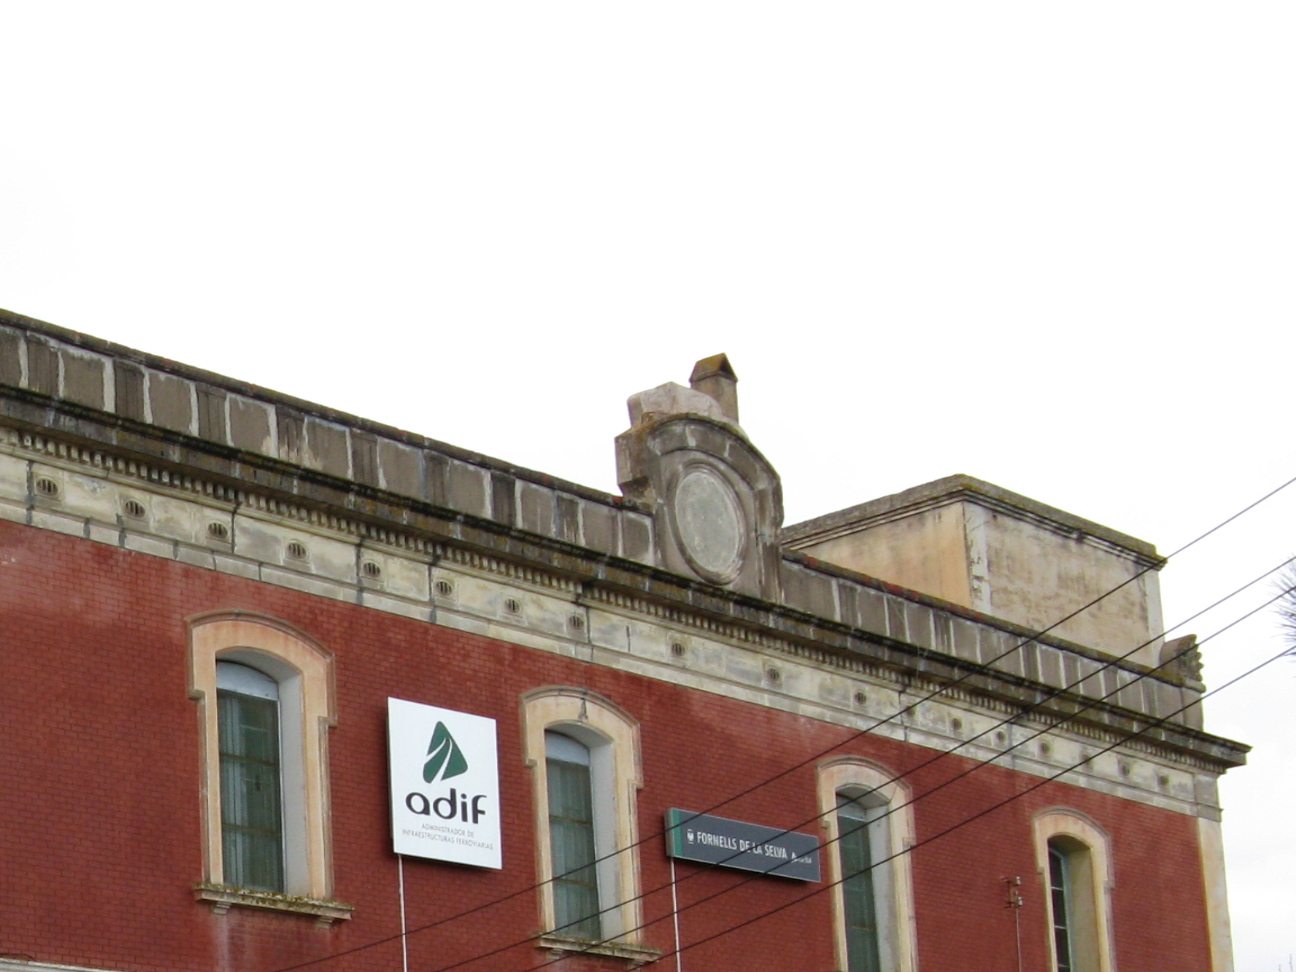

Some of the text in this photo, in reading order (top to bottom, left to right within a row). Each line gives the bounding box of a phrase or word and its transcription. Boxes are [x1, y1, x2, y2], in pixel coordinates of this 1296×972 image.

[405, 787, 487, 824] adif
[402, 829, 494, 850] INFRAESTRUCTURAS FERROVIARIAS
[422, 823, 474, 838] ADMINISTRADOR DE
[696, 831, 787, 859] FORNELLS DE LA SELVA
